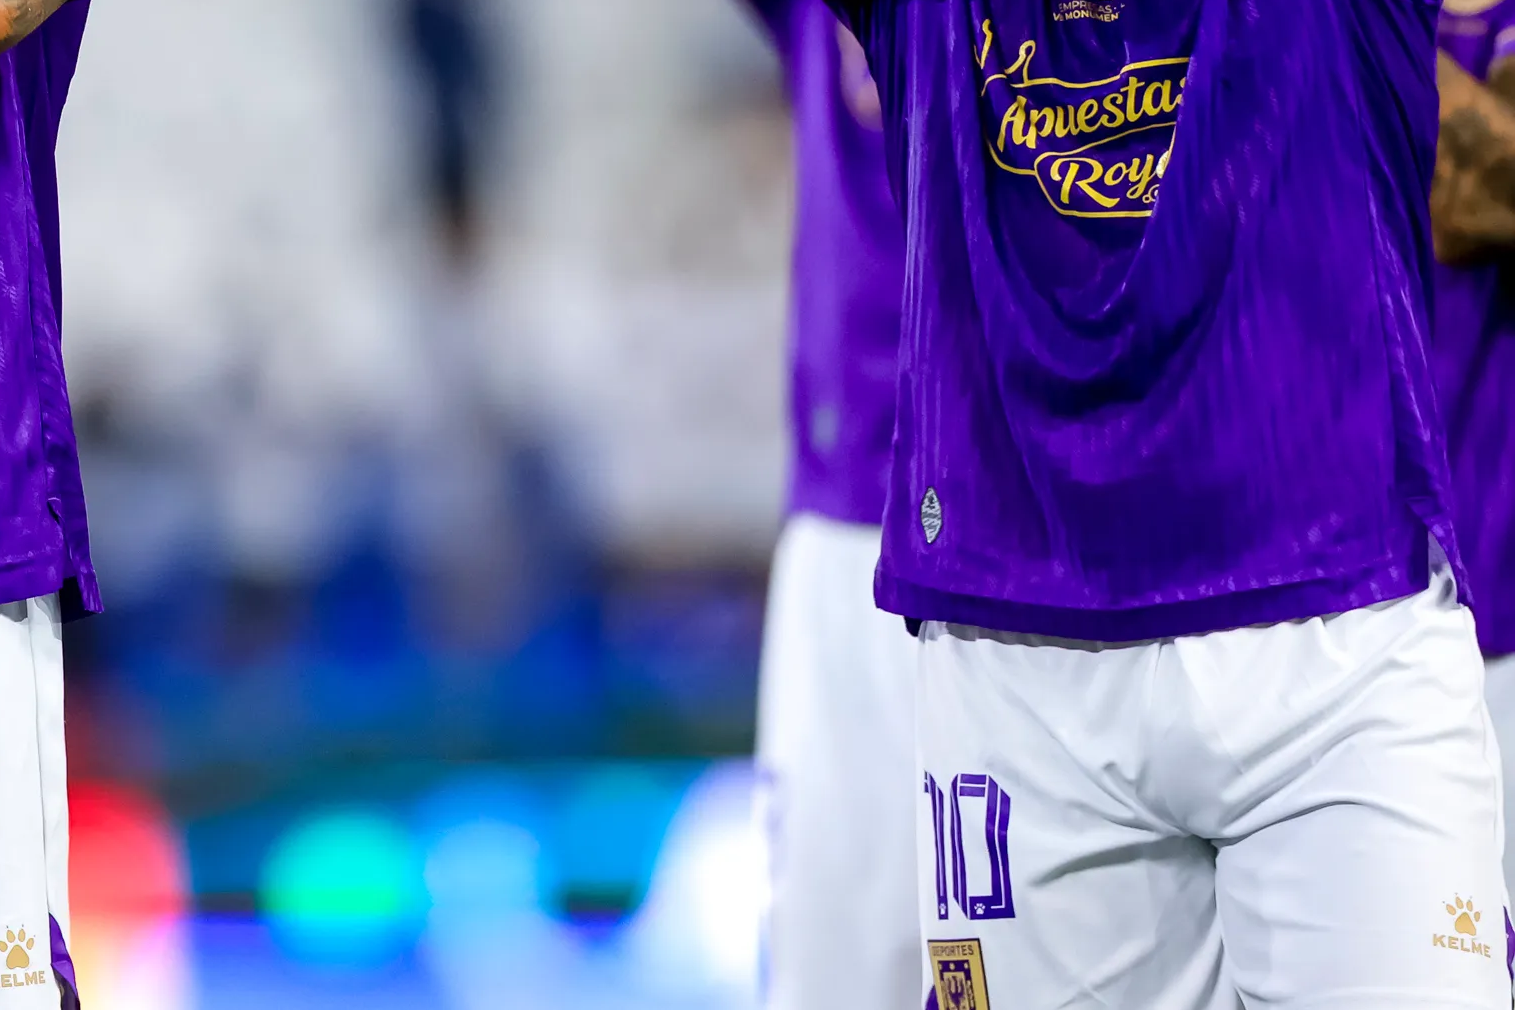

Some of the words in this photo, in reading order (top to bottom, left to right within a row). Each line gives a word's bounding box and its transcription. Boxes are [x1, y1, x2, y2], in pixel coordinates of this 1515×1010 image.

[1050, 150, 1170, 208] Roy
[924, 769, 1016, 920] 10
[1432, 933, 1491, 959] KELME
